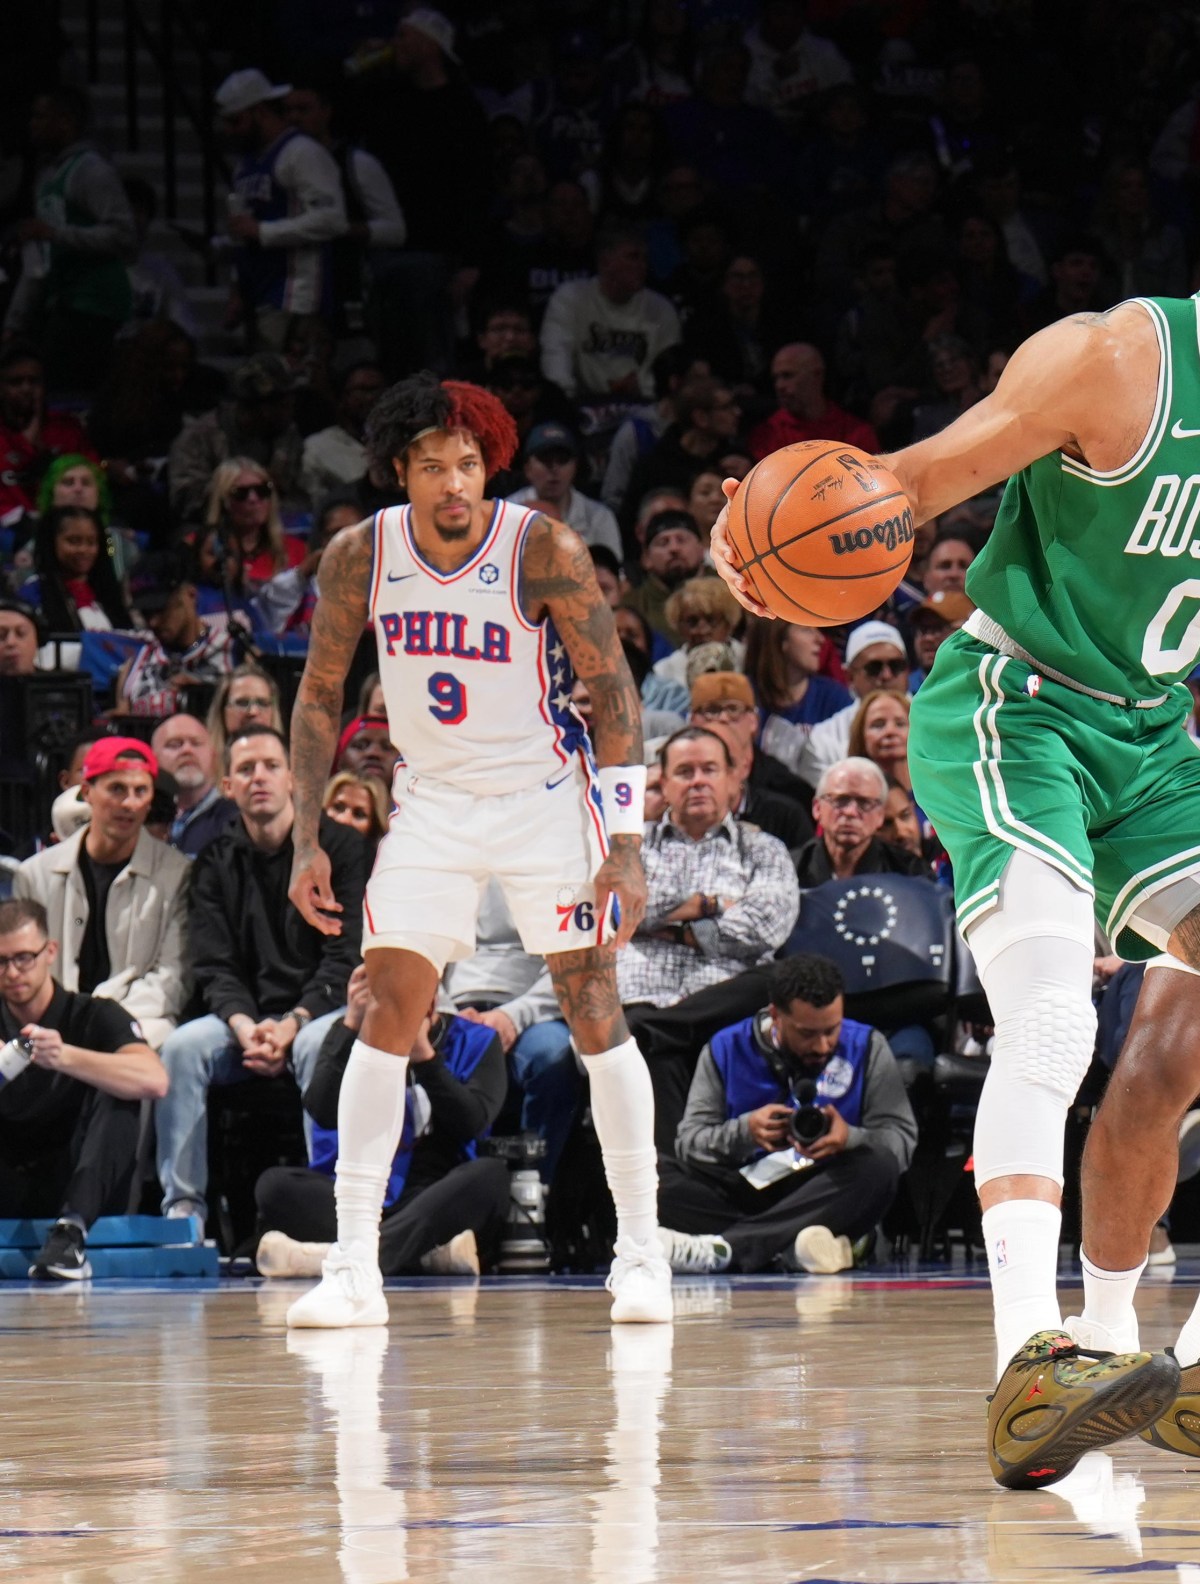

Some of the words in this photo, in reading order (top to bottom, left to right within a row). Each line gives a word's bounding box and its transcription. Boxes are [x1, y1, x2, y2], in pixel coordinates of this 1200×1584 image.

[828, 506, 914, 555] Wilson
[379, 610, 512, 663] PHILA
[427, 671, 468, 725] 9
[614, 782, 632, 807] 9
[556, 901, 595, 932] 76
